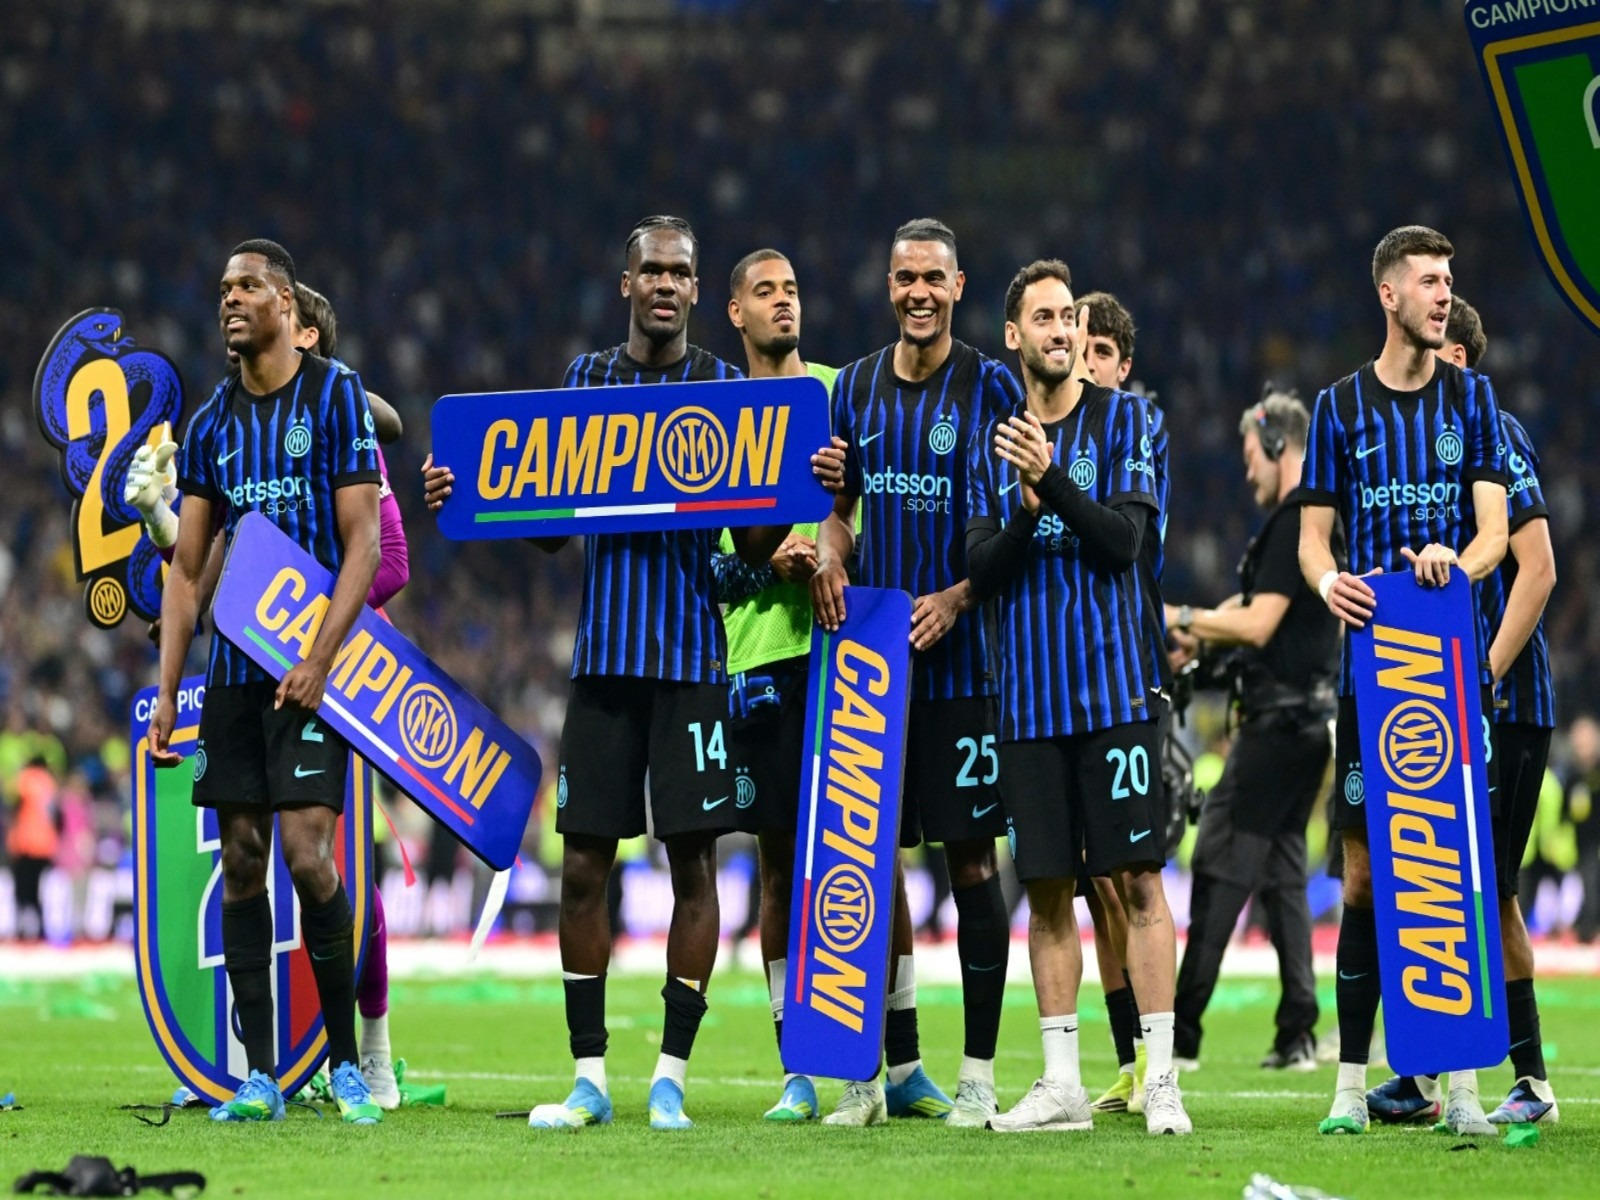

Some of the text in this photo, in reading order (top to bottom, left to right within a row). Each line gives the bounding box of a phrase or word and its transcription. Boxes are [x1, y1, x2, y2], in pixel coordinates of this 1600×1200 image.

[1471, 0, 1597, 28] CAMPIO
[477, 405, 790, 500] CAMPIONI
[862, 465, 952, 498] betsson
[1359, 477, 1461, 509] betsson
[687, 720, 728, 772] 14
[955, 734, 999, 787] 25
[1105, 745, 1149, 800] 20
[810, 639, 891, 1034] CAMPIONI
[1372, 624, 1473, 1017] CAMPIONI
